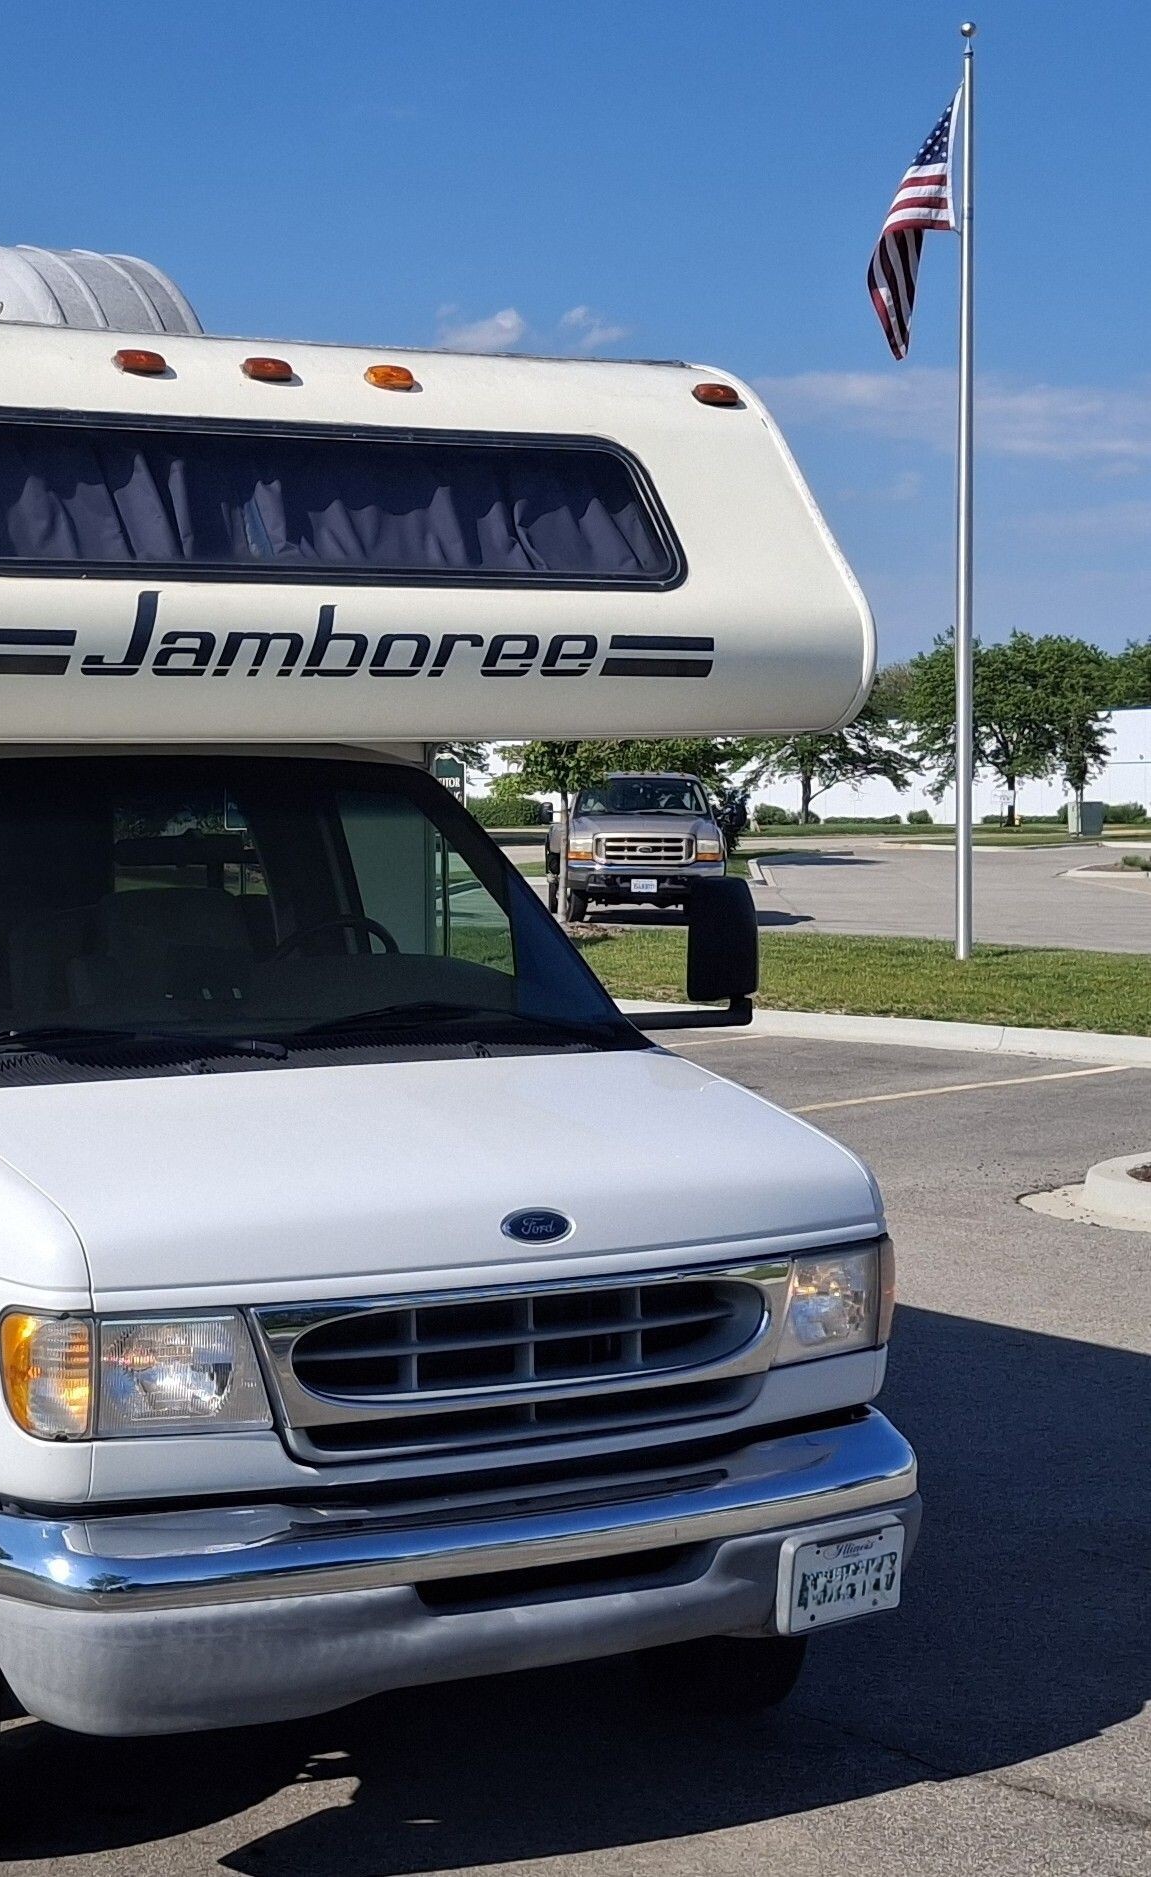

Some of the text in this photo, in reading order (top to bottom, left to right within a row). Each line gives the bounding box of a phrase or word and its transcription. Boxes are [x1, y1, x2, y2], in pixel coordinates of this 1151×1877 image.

[80, 590, 598, 677] Jamboree
[520, 1216, 556, 1235] Ford
[824, 1541, 875, 1560] Illinois
